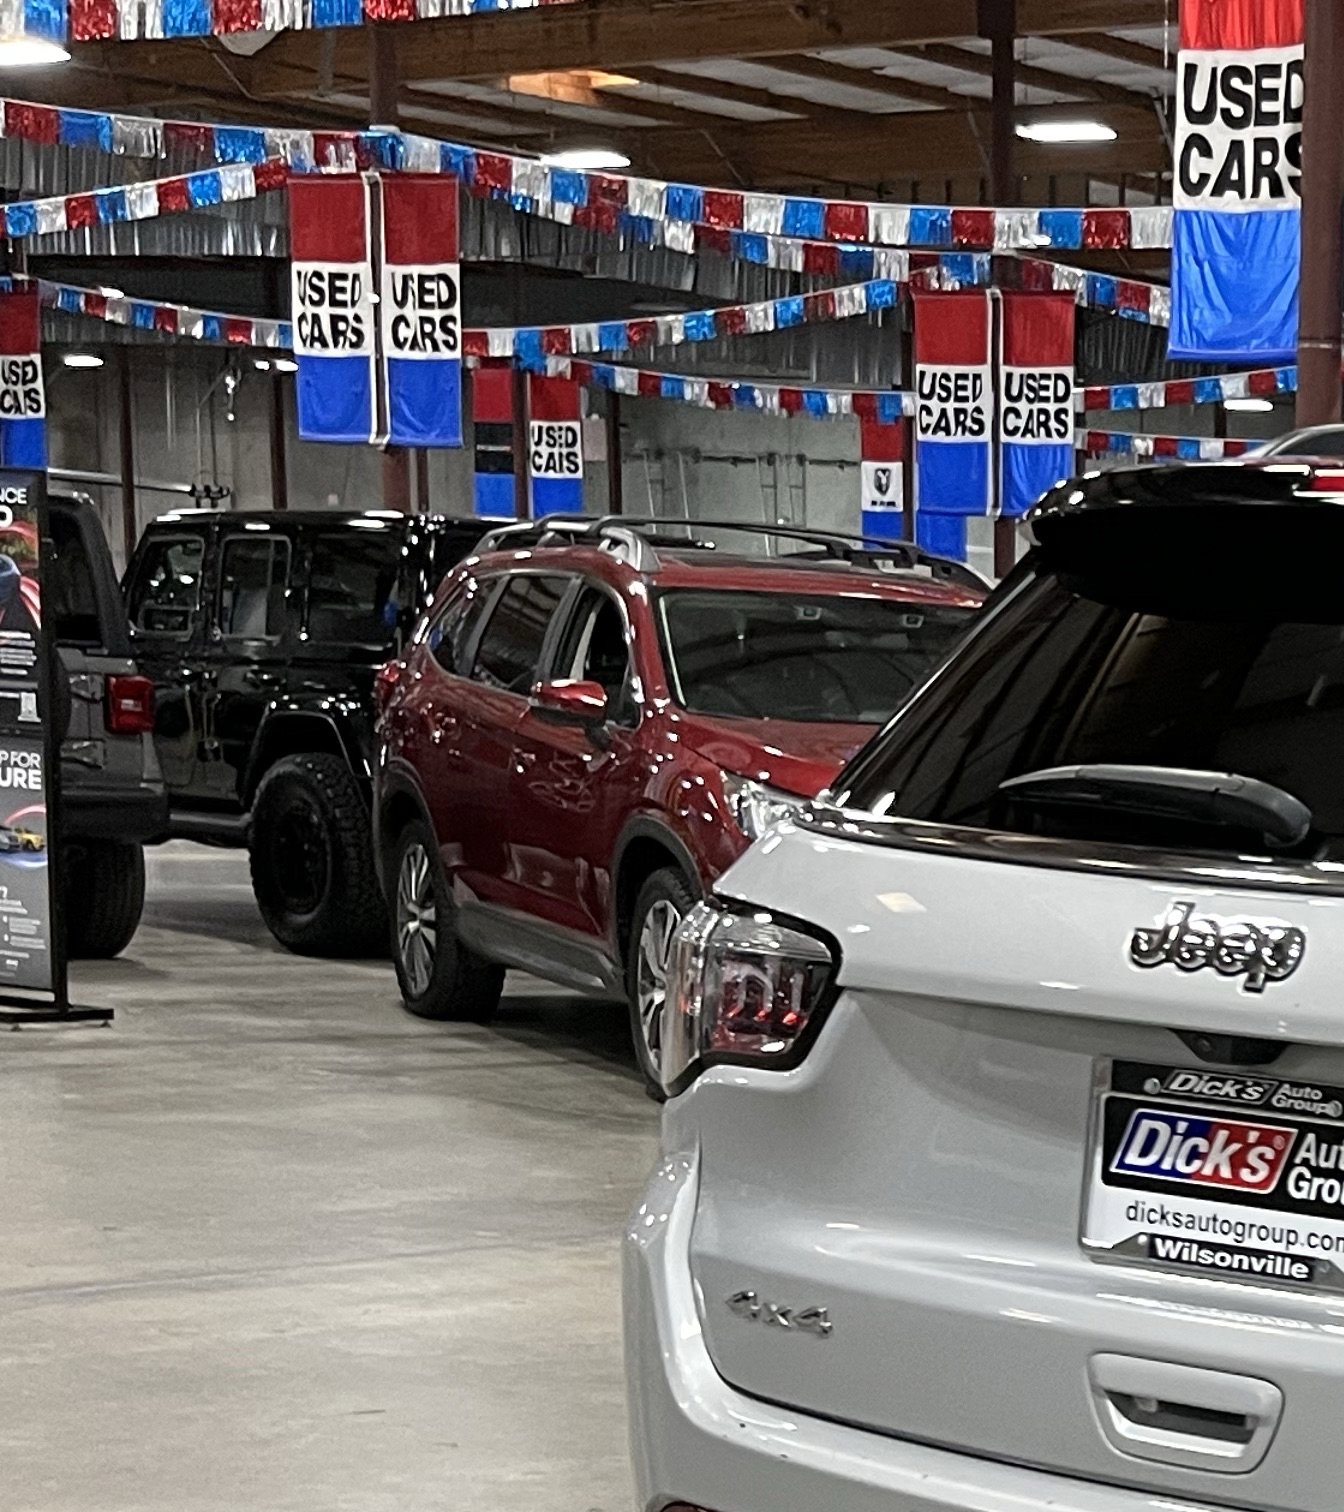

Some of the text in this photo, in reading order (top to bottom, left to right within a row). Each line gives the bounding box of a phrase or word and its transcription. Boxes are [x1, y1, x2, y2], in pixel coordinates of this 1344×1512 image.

[1183, 59, 1304, 130] USED
[297, 270, 361, 308] USED
[298, 312, 365, 349] CARS
[391, 314, 458, 352] CARS
[918, 370, 982, 402] USED
[1004, 372, 1071, 403] USED
[918, 404, 985, 437] CARS
[1003, 407, 1069, 438] CARS
[11, 751, 41, 769] FOR
[1130, 901, 1306, 993] Jeep
[1170, 1074, 1264, 1100] Dick's
[1277, 1083, 1322, 1100] Auto
[1272, 1094, 1331, 1114] Group
[1123, 1118, 1275, 1184] Dick's
[1153, 1237, 1310, 1280] Wilsonville
